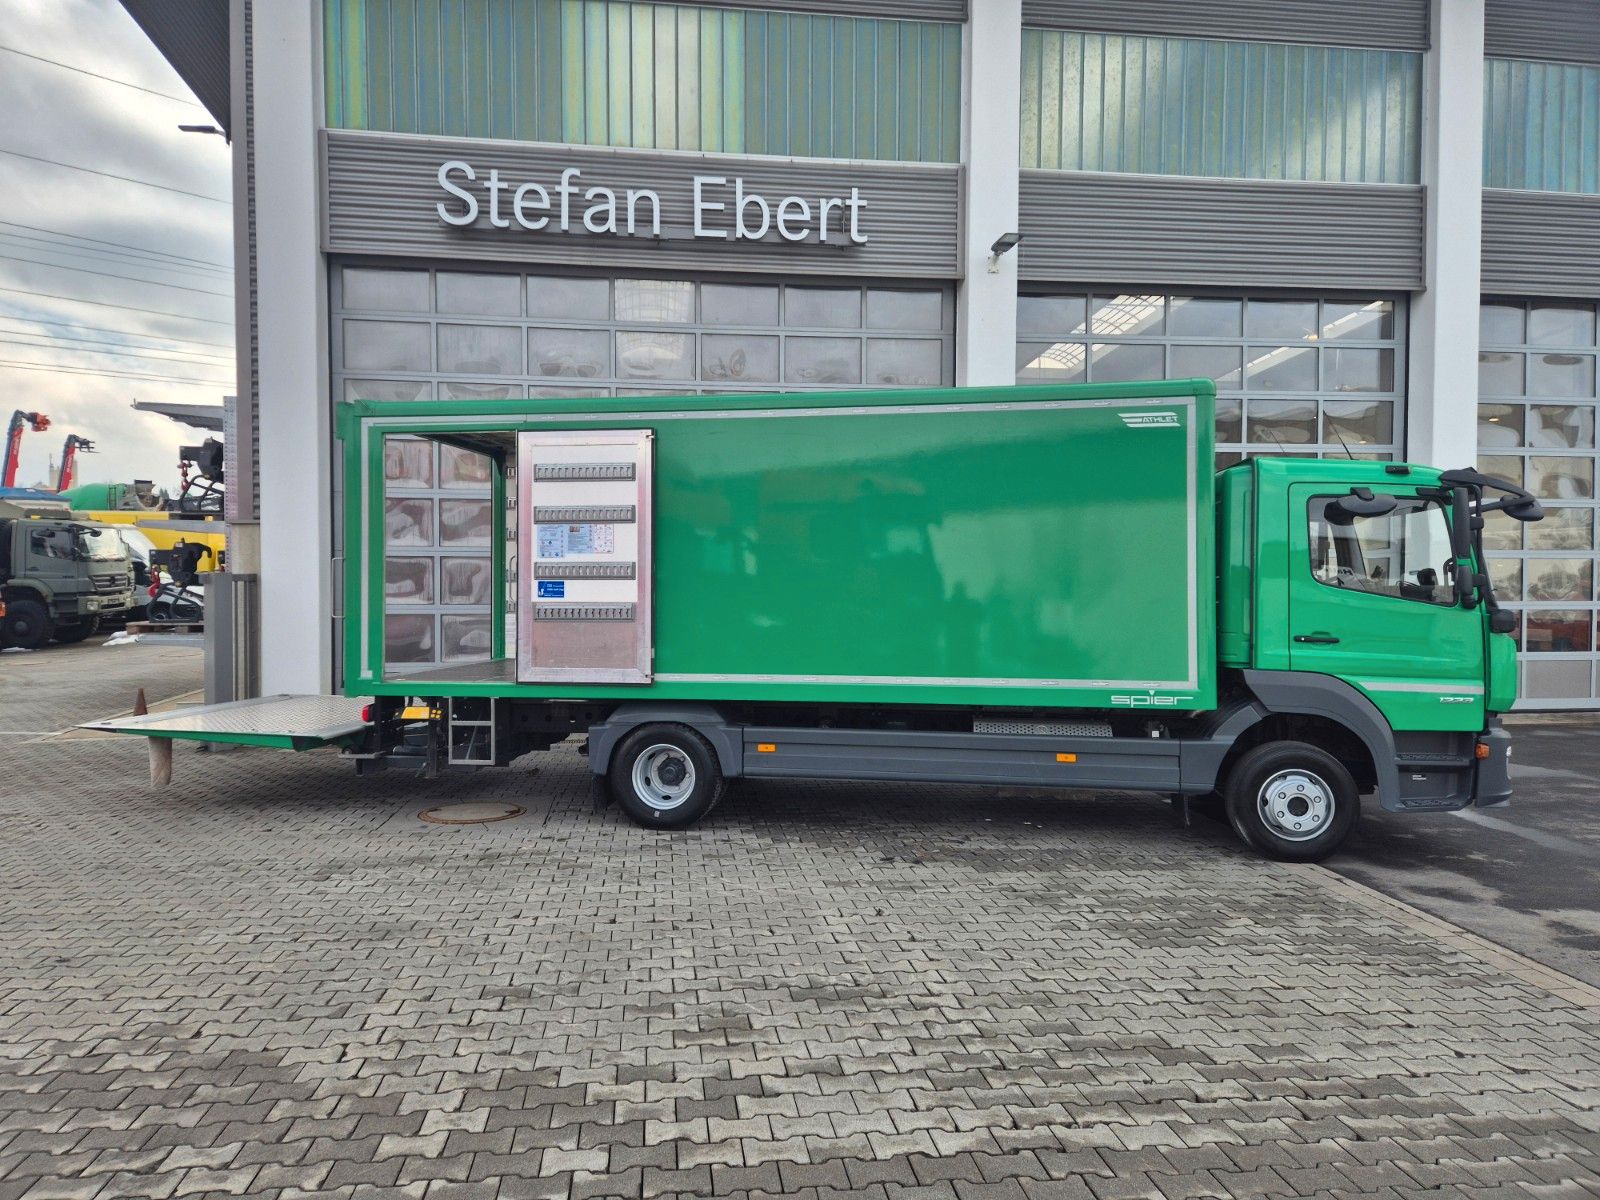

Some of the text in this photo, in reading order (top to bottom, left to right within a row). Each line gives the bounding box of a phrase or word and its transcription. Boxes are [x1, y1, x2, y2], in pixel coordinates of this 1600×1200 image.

[436, 160, 869, 243] Stefan Ebert
[1111, 690, 1194, 708] spier
